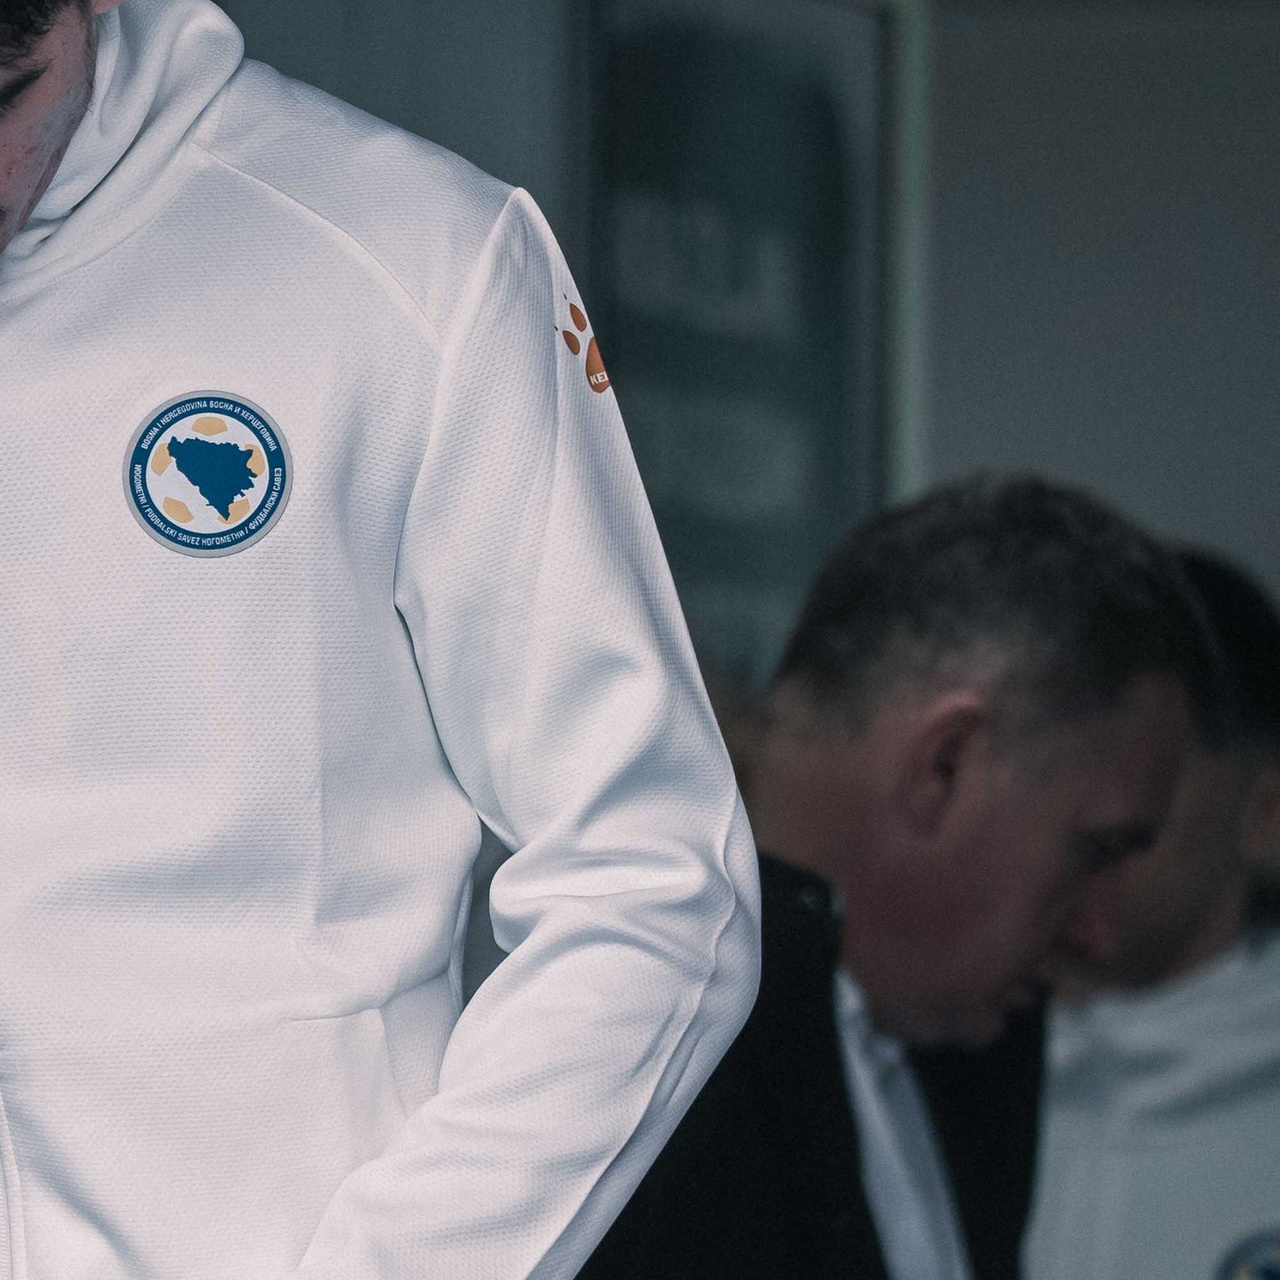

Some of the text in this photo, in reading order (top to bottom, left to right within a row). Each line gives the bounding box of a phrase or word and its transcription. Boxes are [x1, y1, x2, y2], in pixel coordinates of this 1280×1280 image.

[141, 426, 160, 450] BOSNA
[160, 401, 207, 425] HERCEGOVINA
[209, 400, 233, 412] БОСНА
[134, 464, 147, 504] NOGOMETNI
[145, 508, 177, 537] FUDBALSKI
[177, 533, 200, 546] SAVEZ
